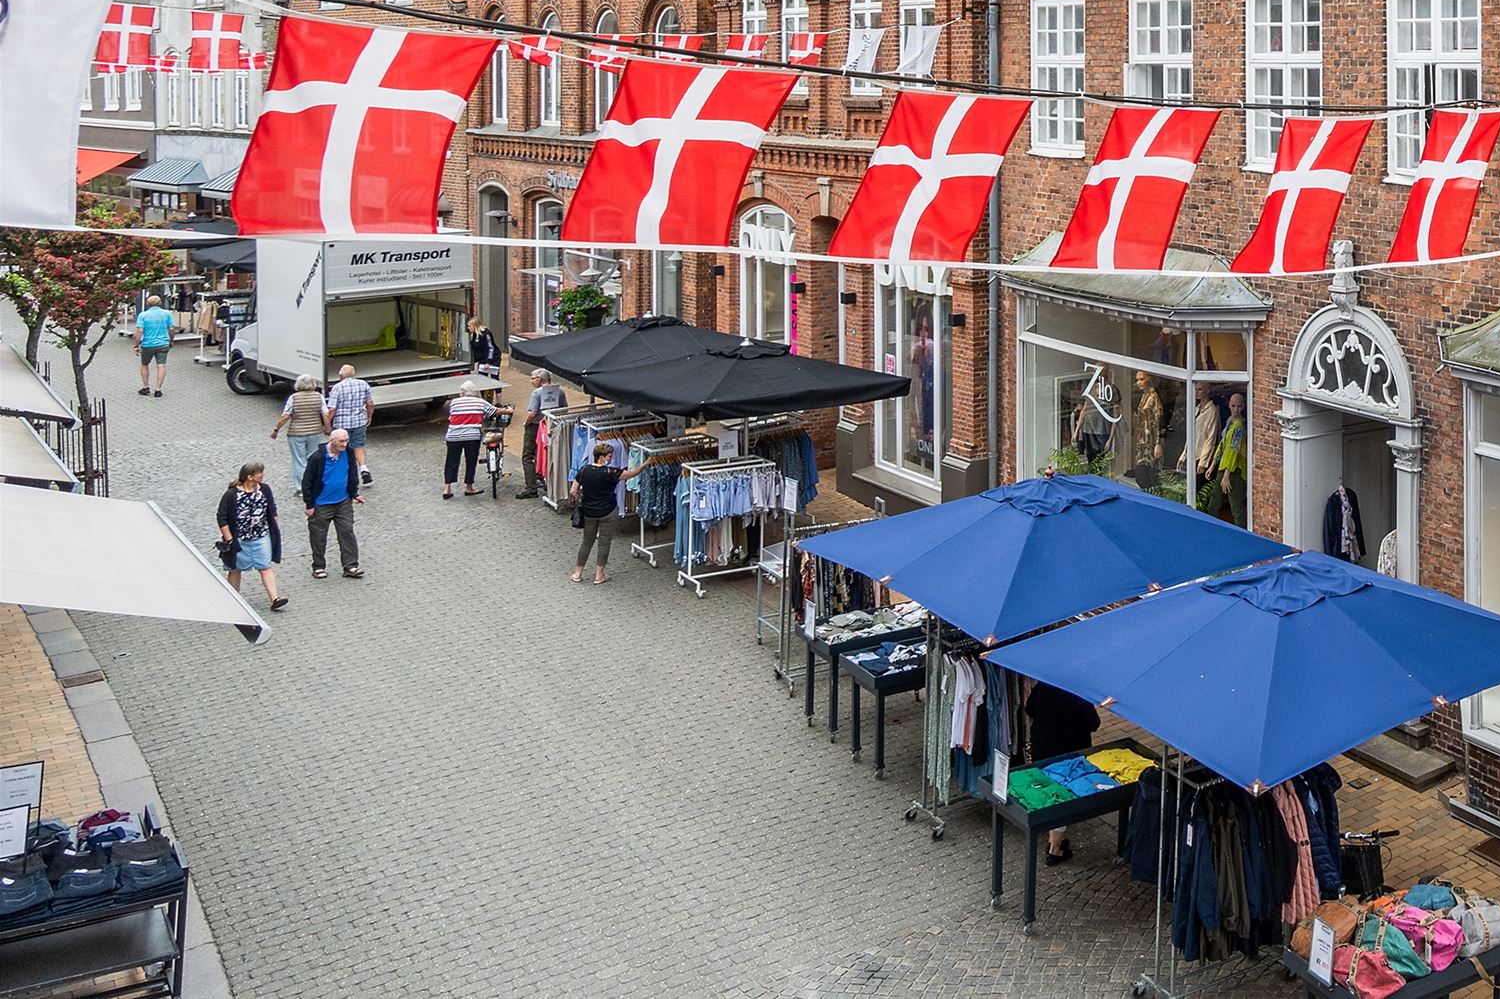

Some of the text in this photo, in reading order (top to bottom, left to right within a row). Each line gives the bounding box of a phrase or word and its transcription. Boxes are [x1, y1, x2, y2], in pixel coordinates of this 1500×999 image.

[547, 168, 581, 191] Sydban
[350, 247, 451, 266] MK Transport
[349, 270, 381, 279] Lagerhotel
[1081, 361, 1122, 423] Zilo
[917, 439, 935, 455] ONL
